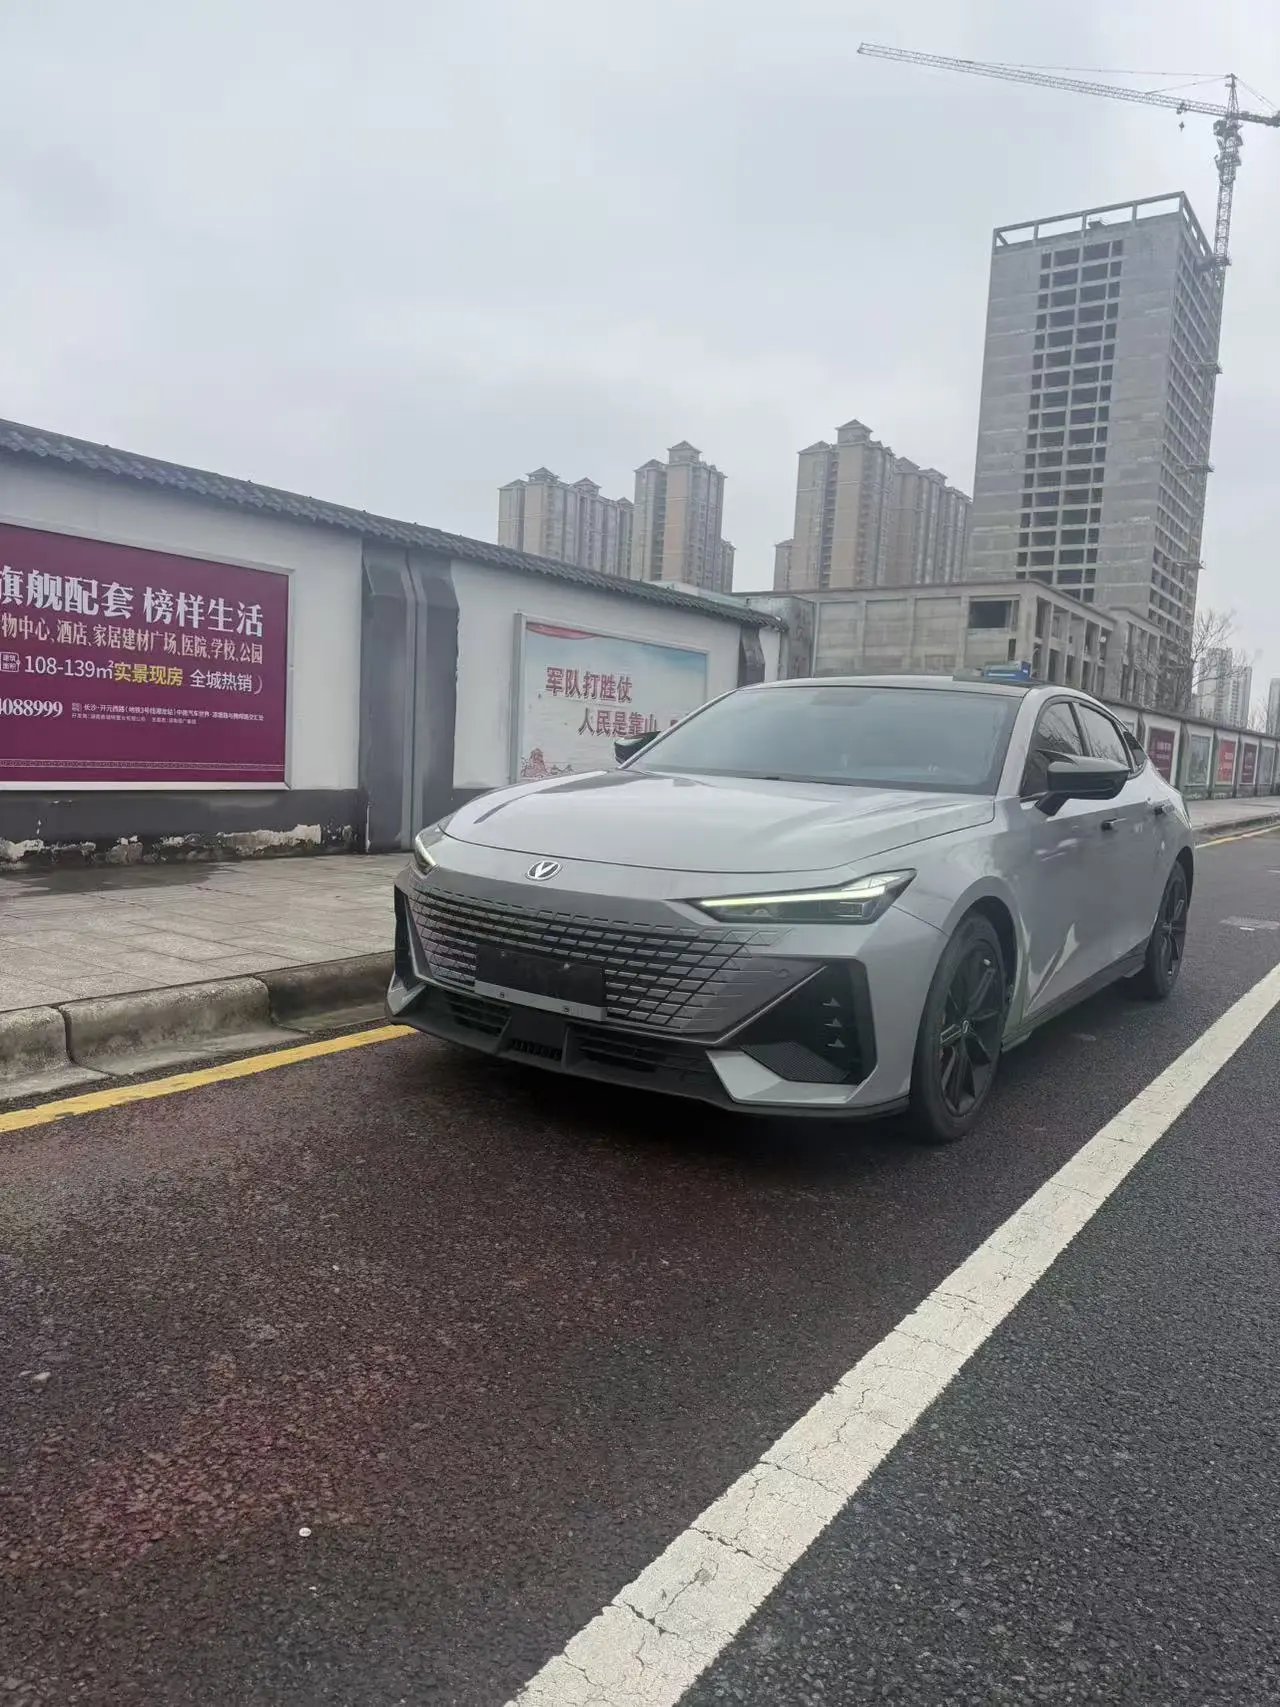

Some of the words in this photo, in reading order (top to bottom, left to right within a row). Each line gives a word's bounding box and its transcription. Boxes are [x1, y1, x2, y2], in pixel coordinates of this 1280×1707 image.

[0, 565, 134, 619] 旗舰配套
[143, 586, 263, 637] 榜样生活
[545, 666, 632, 703] 军队打胜仗
[0, 698, 63, 717] 088999
[578, 707, 657, 737] 人民是靠山
